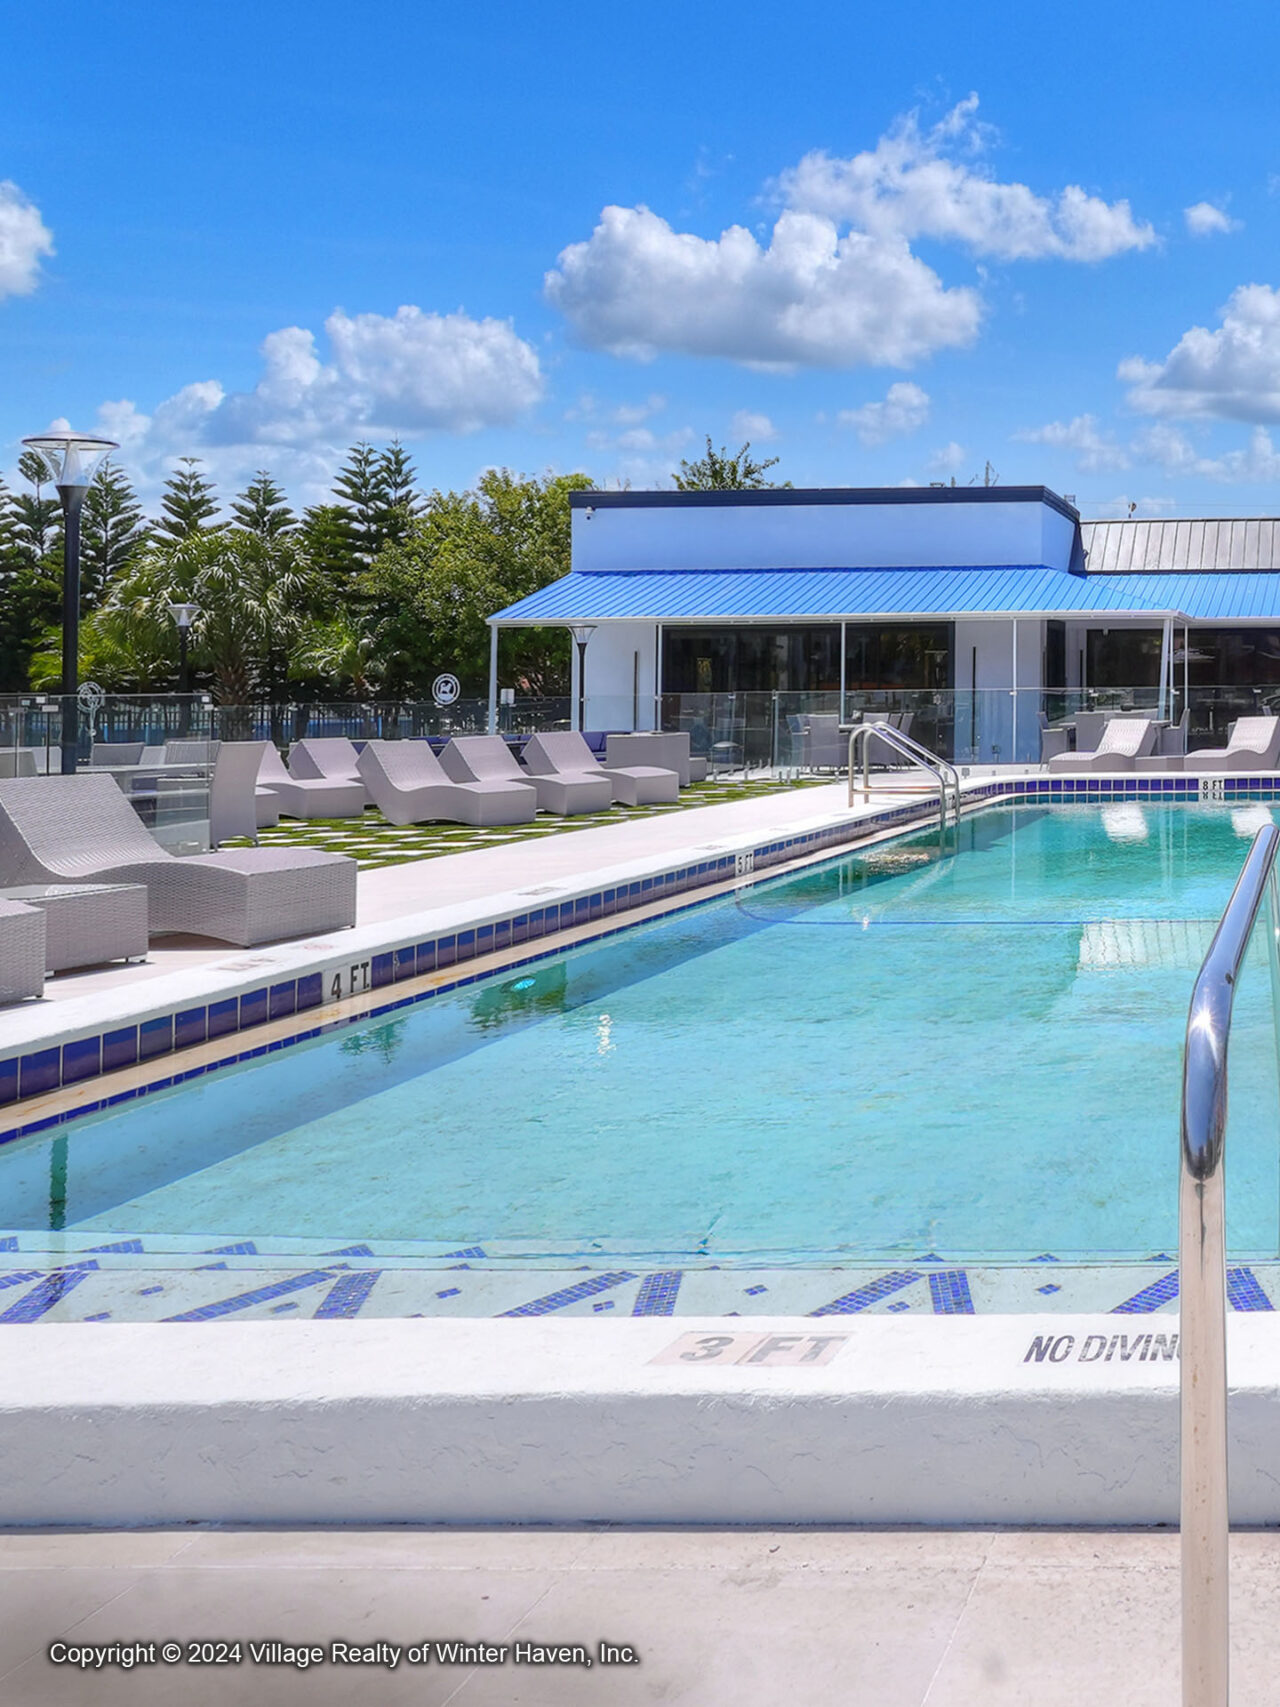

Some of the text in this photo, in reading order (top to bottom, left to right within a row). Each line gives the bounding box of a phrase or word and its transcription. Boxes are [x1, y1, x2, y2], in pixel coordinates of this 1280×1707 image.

[331, 973, 342, 999] 4
[679, 1336, 848, 1363] 3 FT
[1023, 1334, 1182, 1363] NO DIVIN
